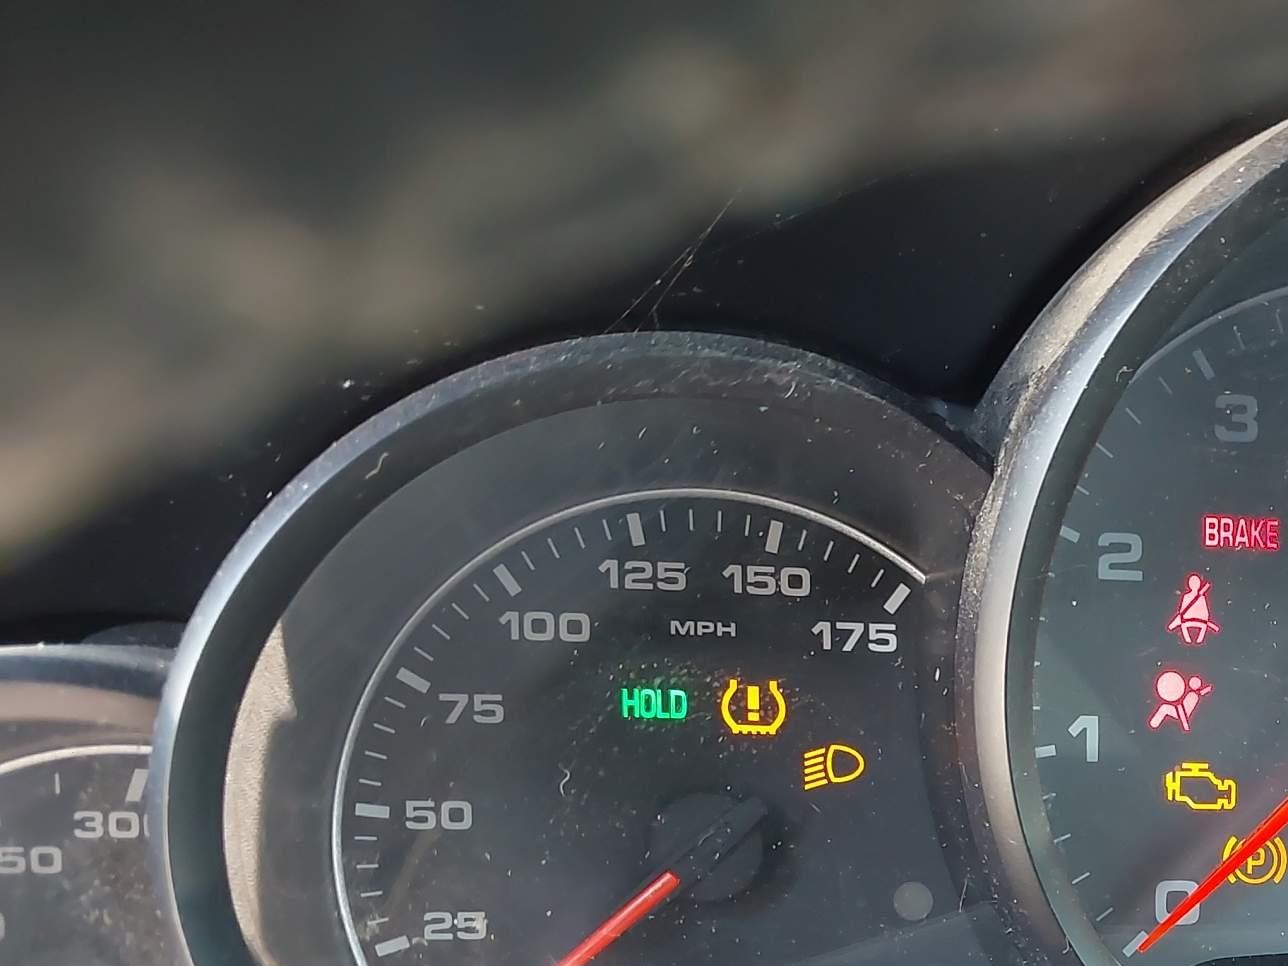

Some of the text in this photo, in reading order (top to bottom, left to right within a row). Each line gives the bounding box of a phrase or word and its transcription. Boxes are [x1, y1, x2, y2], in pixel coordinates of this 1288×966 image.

[1214, 395, 1259, 442] 3
[1204, 517, 1279, 550] BRAKE
[1098, 532, 1143, 582] 2
[599, 560, 686, 590] 125
[722, 564, 811, 597] 150
[499, 611, 591, 642] 100
[670, 620, 736, 637] MPH
[812, 621, 898, 653] 175
[438, 693, 505, 724] 75
[621, 687, 688, 719] HOLD
[1067, 715, 1099, 762] 1
[73, 811, 150, 839] 30
[405, 798, 473, 831] 50
[1155, 880, 1200, 925] 0
[423, 911, 487, 940] 25
